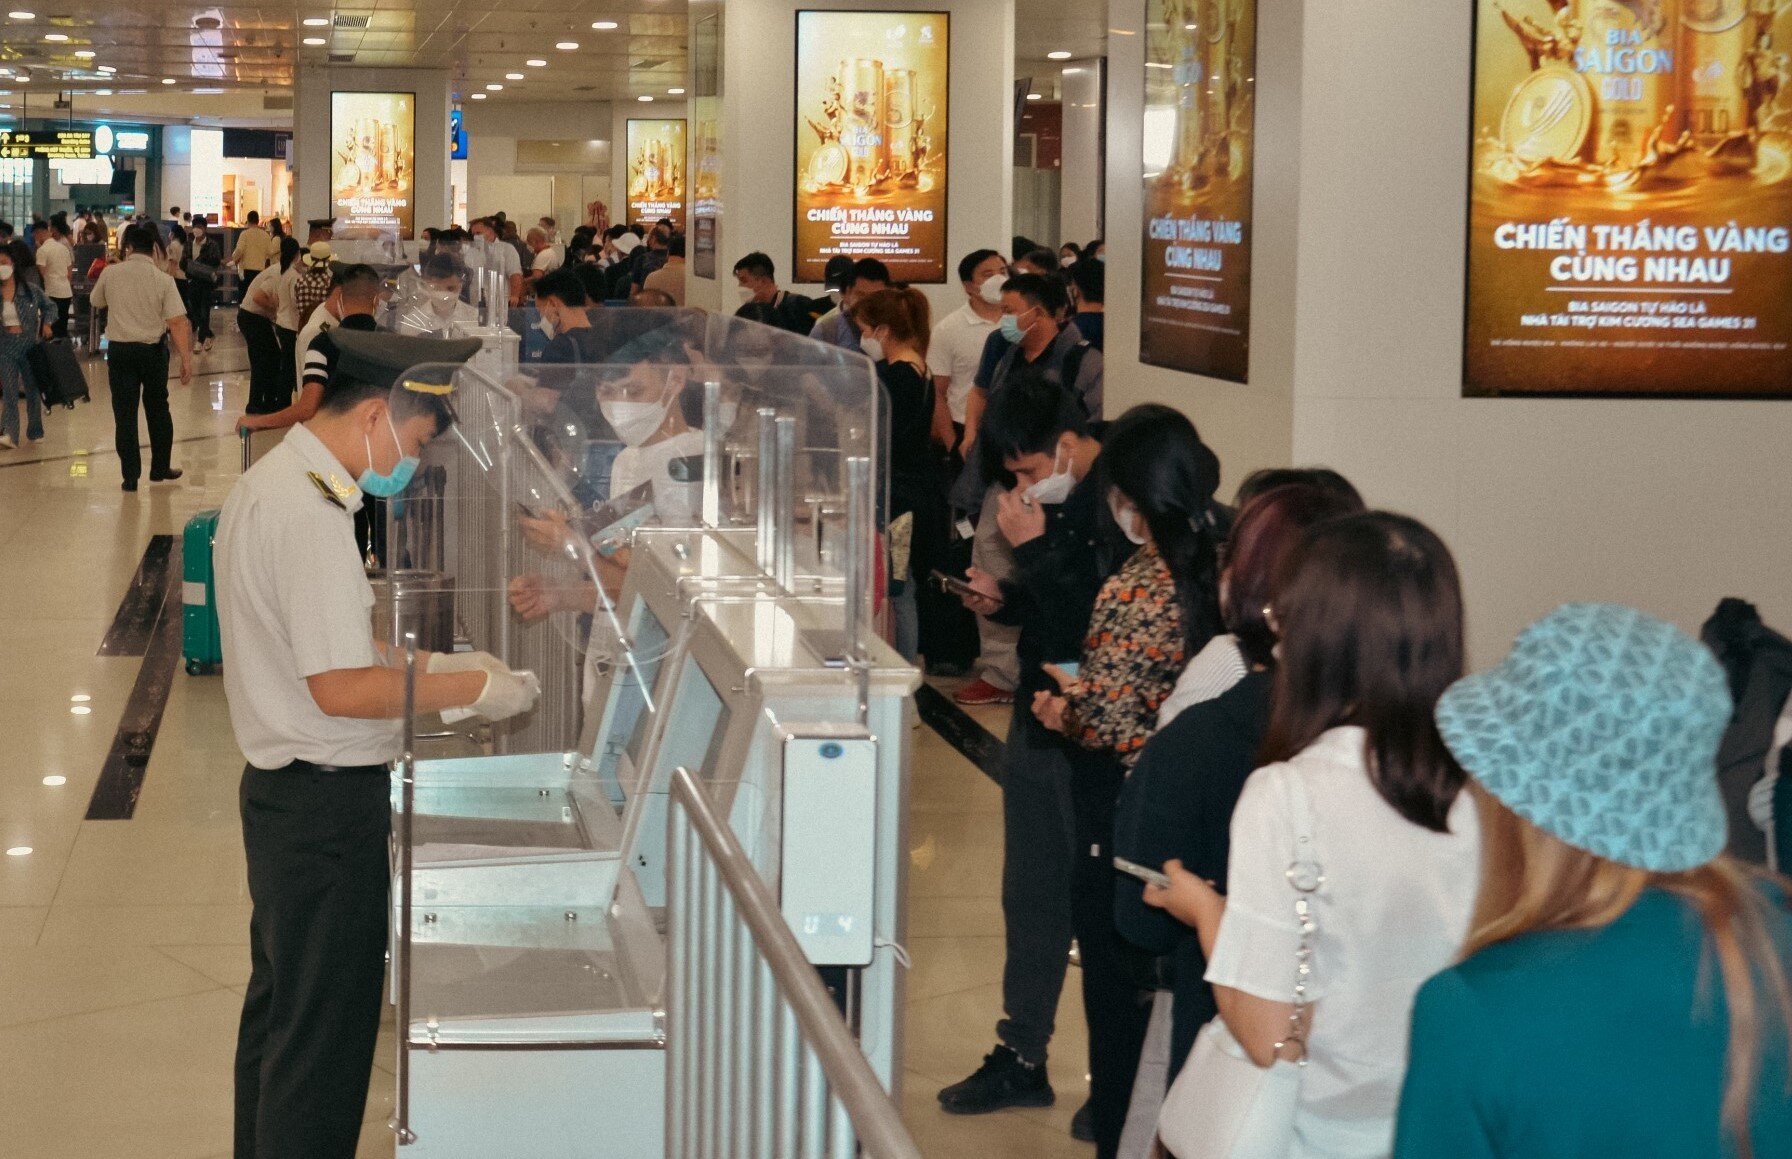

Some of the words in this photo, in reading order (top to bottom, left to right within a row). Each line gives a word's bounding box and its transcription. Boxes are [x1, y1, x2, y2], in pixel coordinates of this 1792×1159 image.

[1606, 28, 1642, 45] BIA
[896, 208, 934, 222] VÀNG
[871, 223, 909, 235] NHAU
[1494, 216, 1586, 250] CHIẾN
[1592, 218, 1698, 252] THẮNG
[1703, 219, 1789, 253] VÀNG
[1549, 249, 1639, 282] CÙNG
[1644, 256, 1731, 283] NHAU
